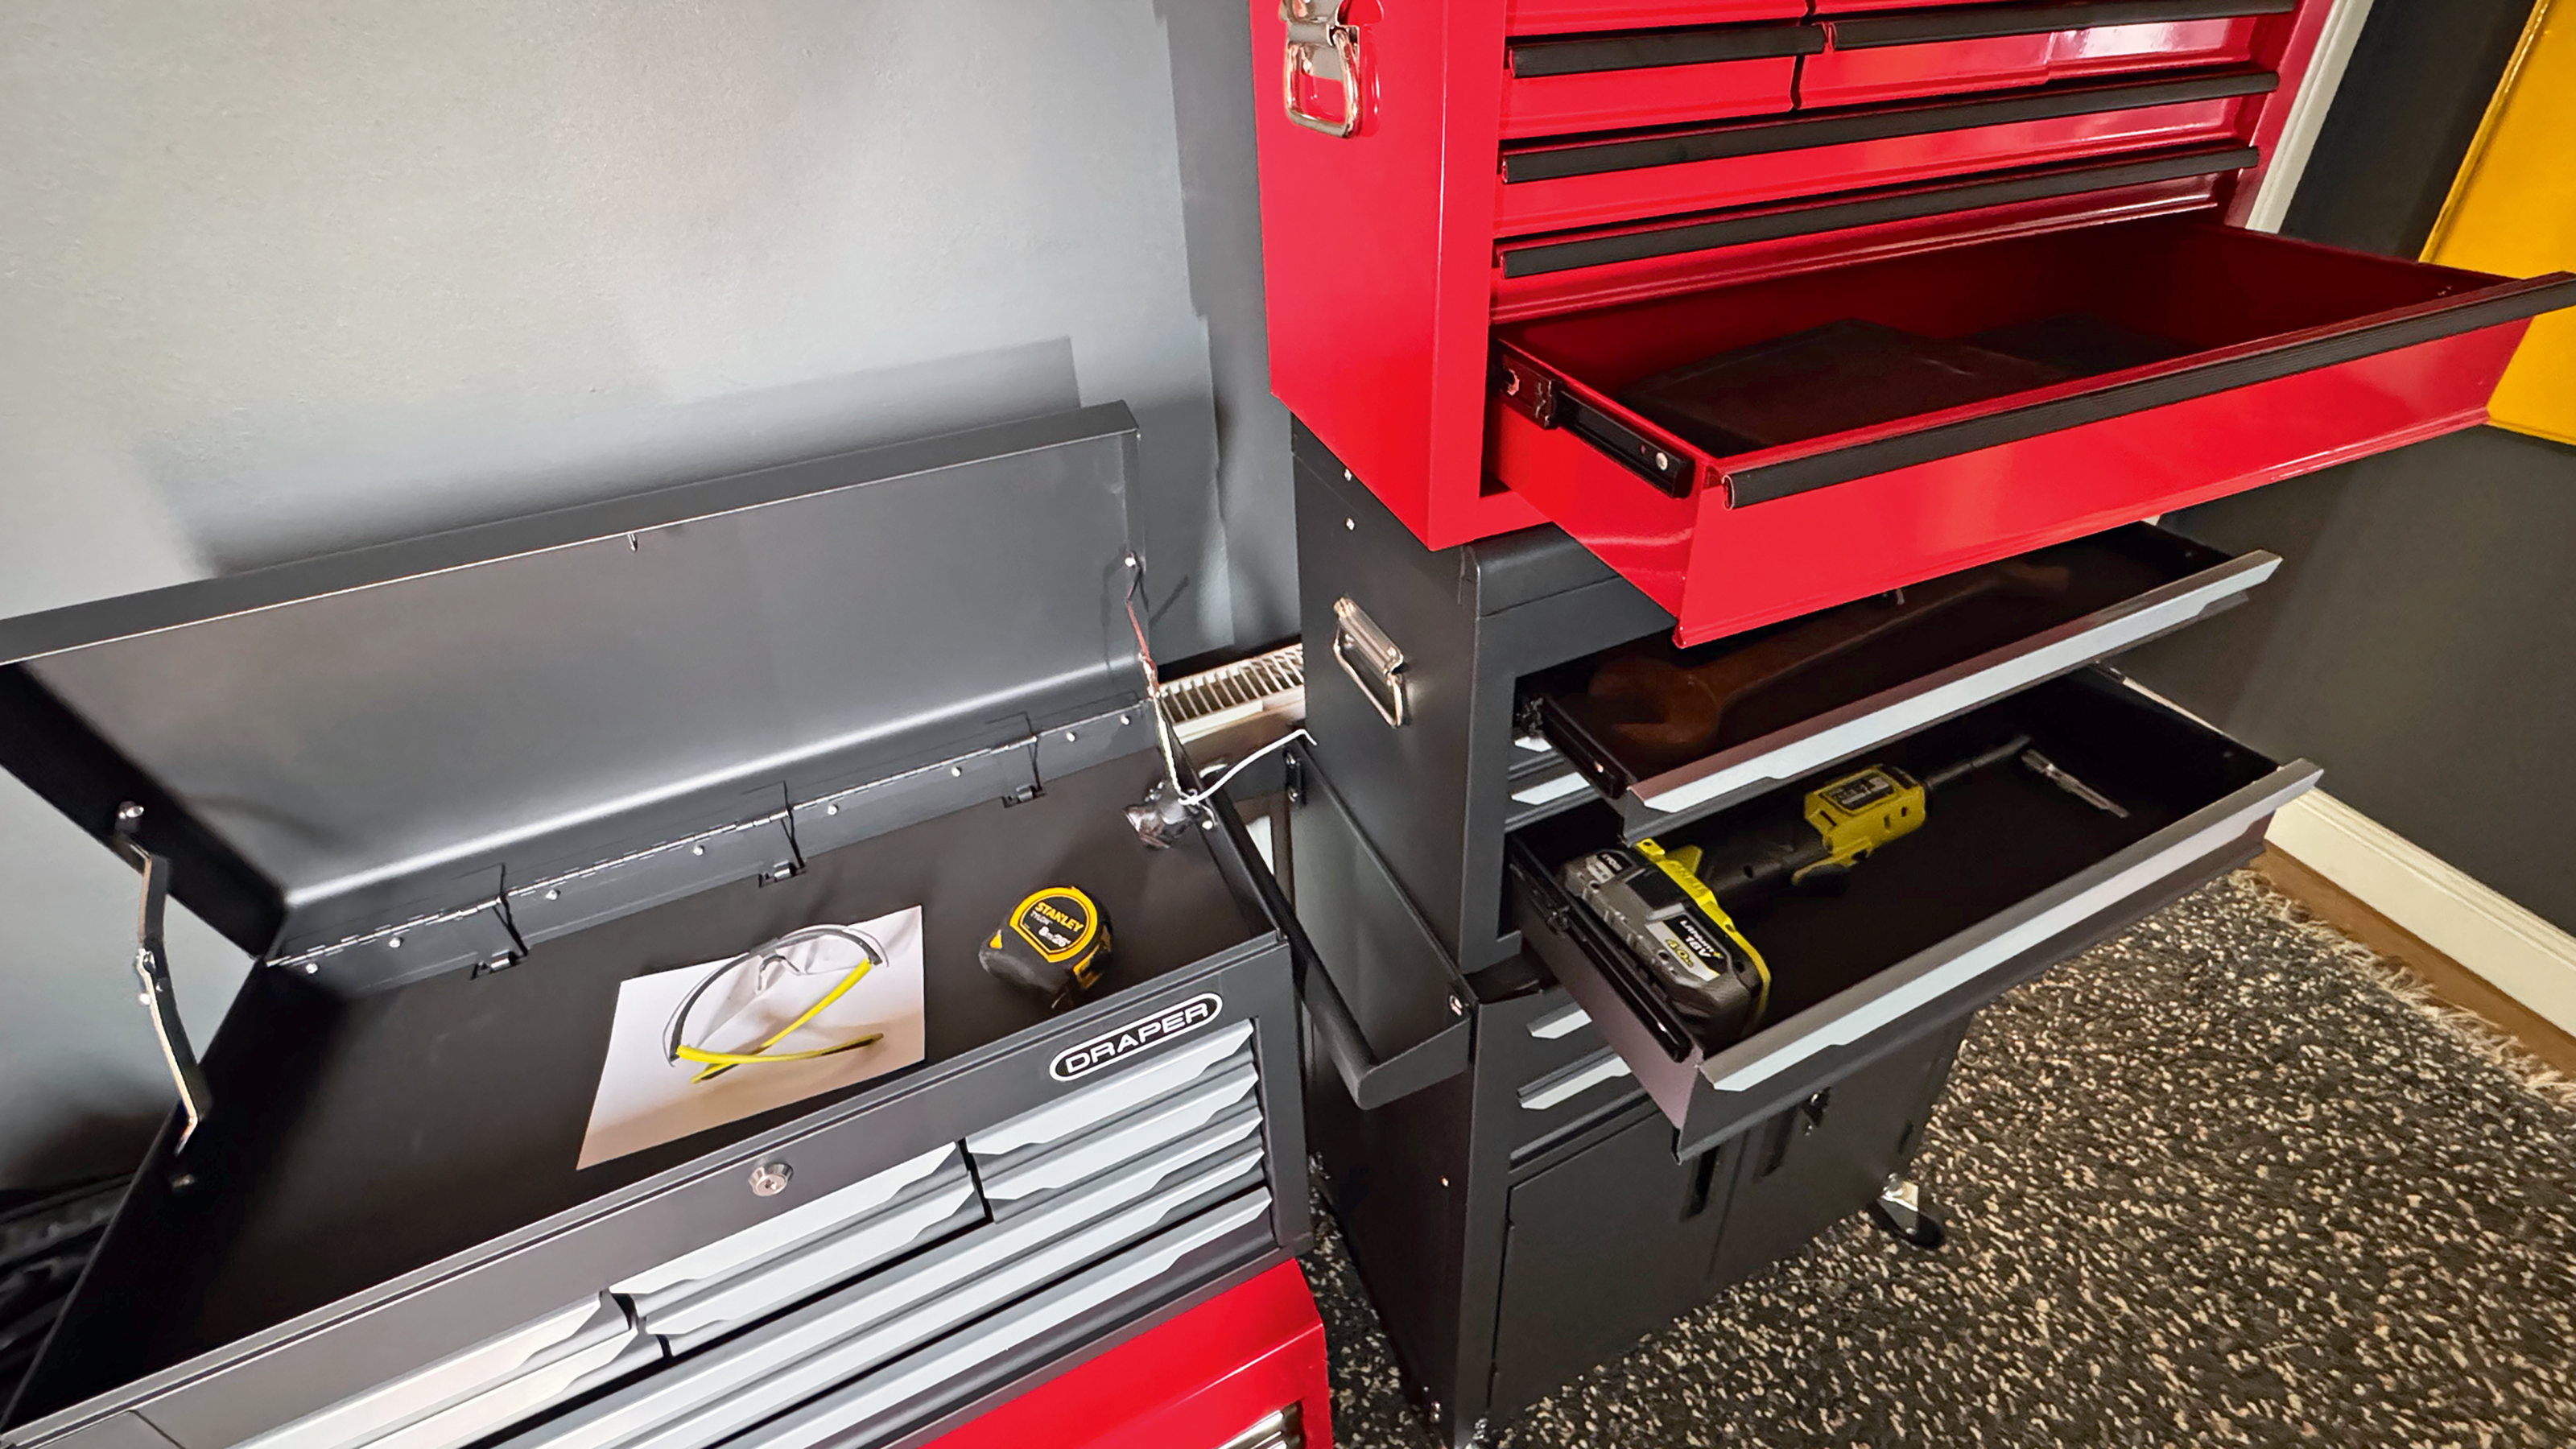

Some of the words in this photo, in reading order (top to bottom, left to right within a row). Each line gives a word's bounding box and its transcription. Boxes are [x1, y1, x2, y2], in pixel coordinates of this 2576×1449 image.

[1034, 902, 1084, 932] STANLEY
[1685, 935, 1711, 958] 18V
[1065, 1003, 1208, 1074] DRAPER
